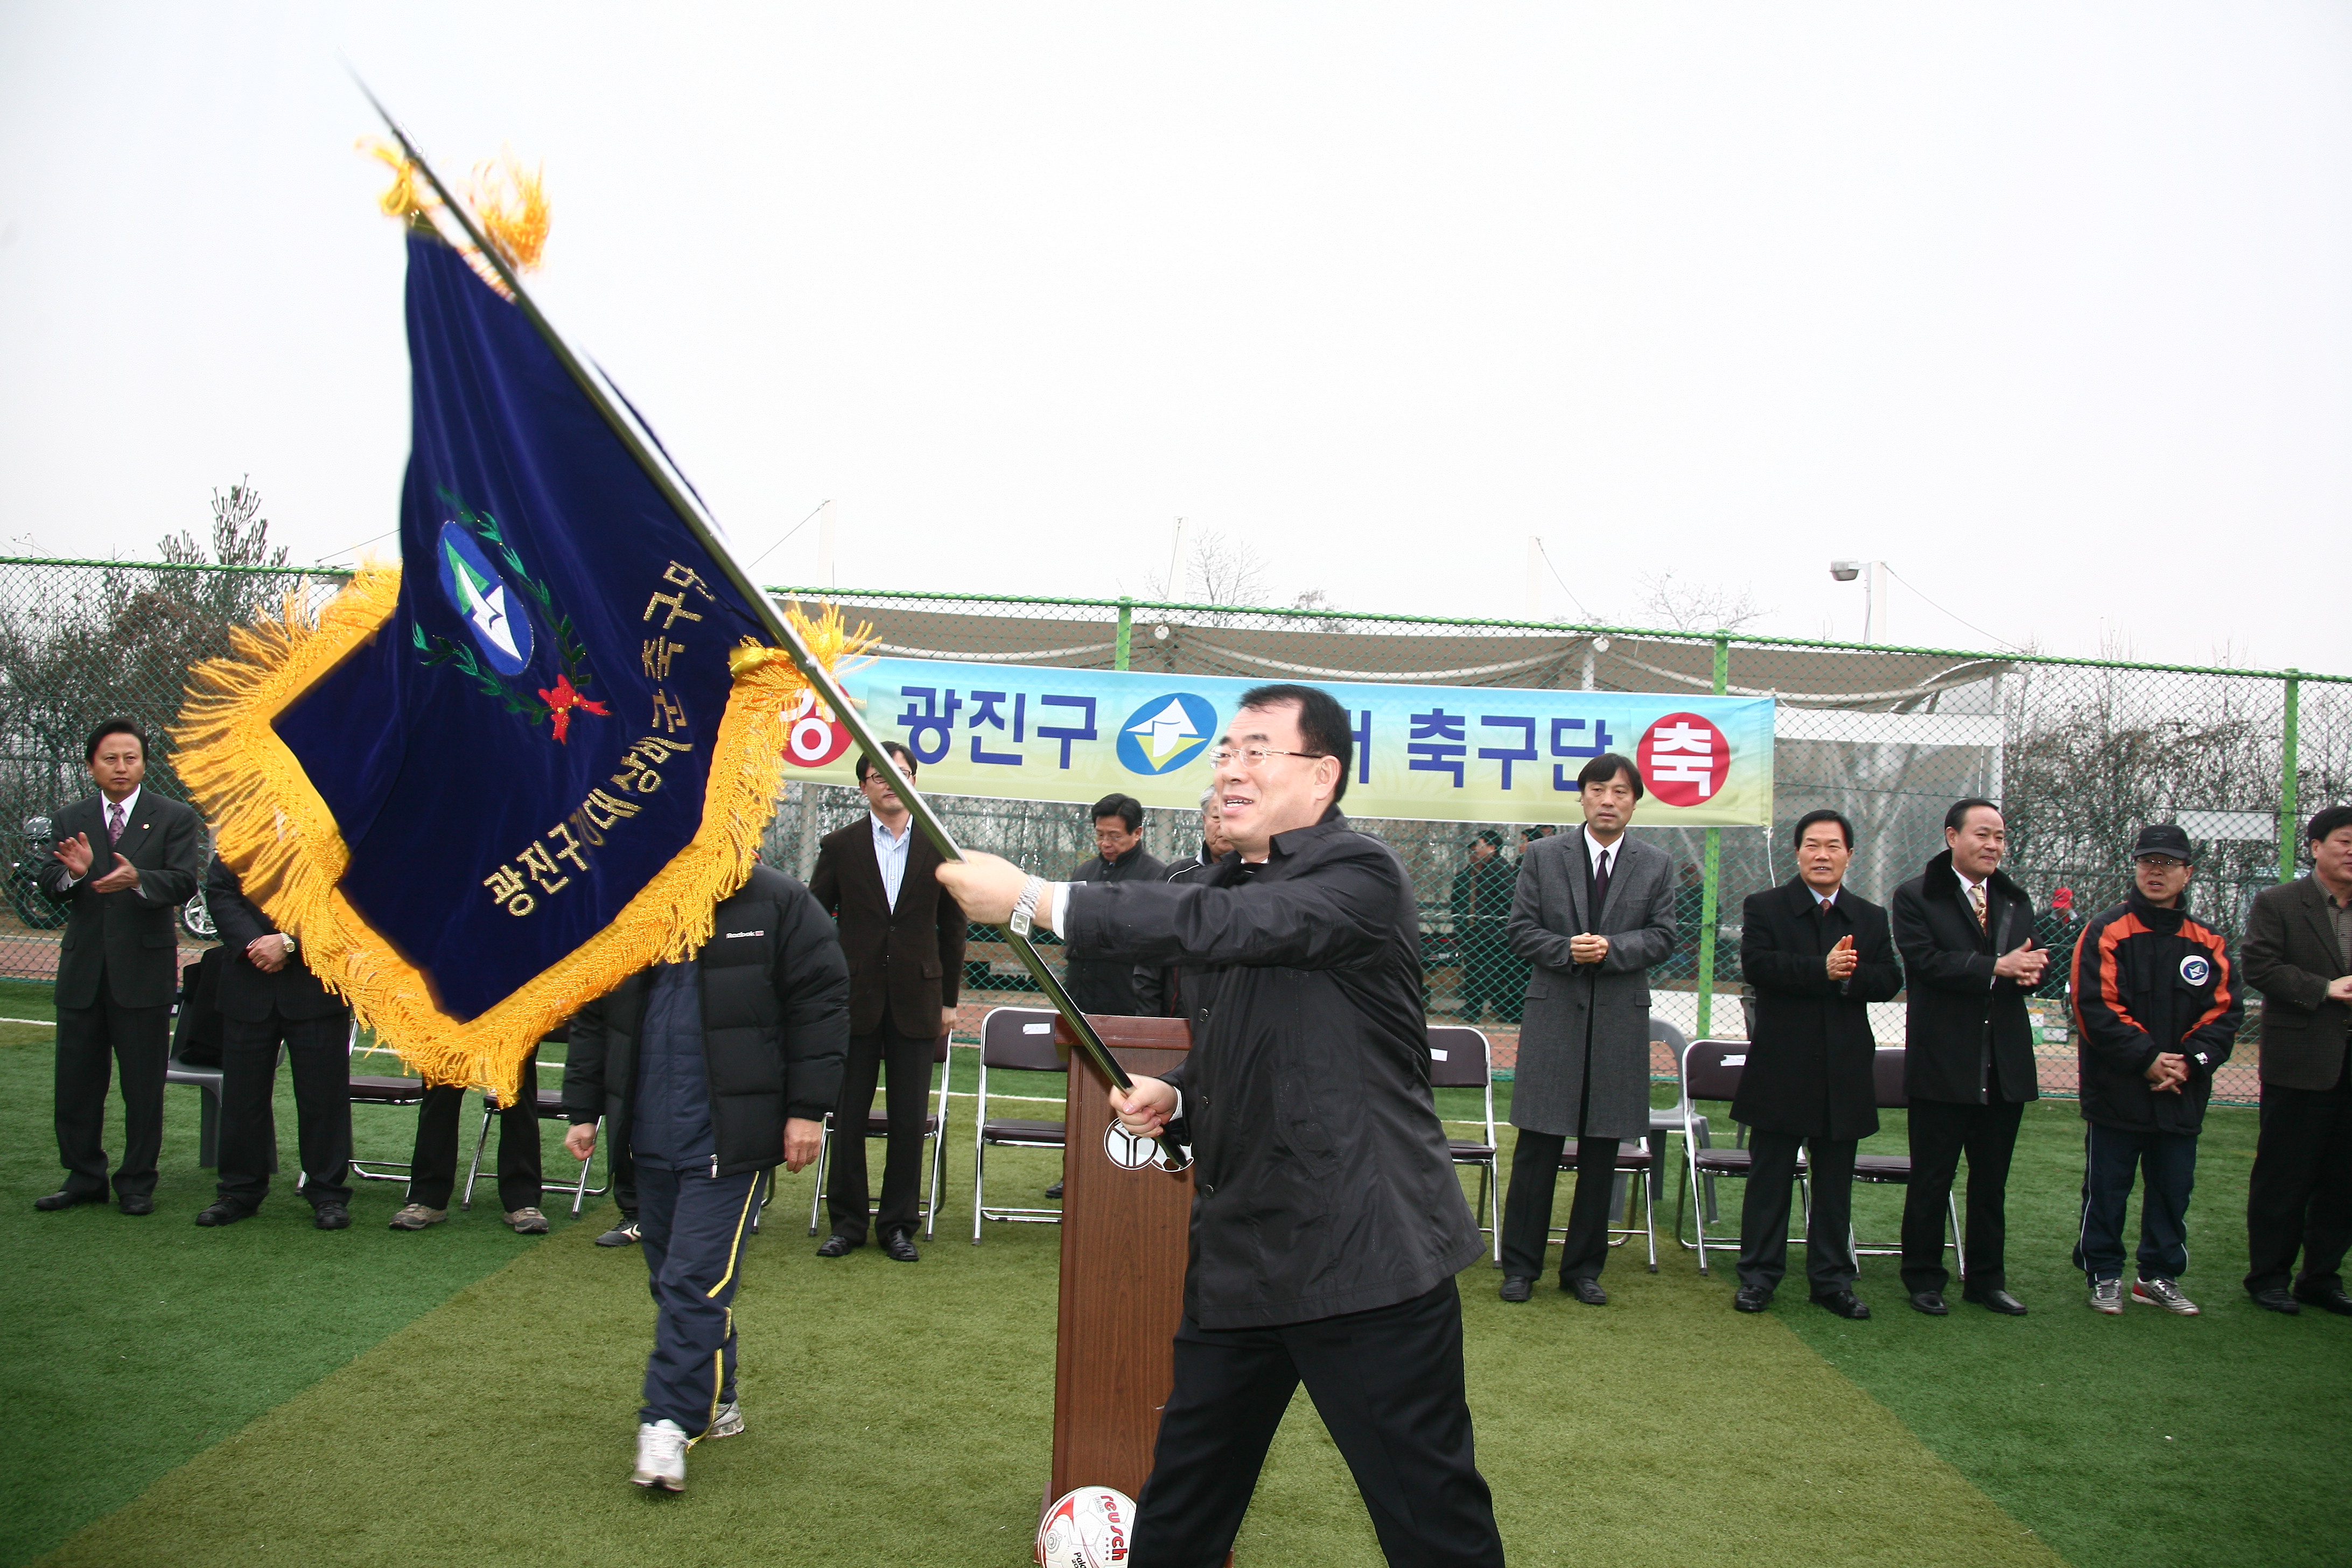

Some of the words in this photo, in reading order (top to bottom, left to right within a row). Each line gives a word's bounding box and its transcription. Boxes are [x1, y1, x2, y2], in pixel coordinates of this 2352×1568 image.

[897, 685, 1097, 769] 광진구
[1407, 708, 1613, 792] 축구단
[1650, 722, 1713, 797] 축
[1100, 1495, 1128, 1561] reusch
